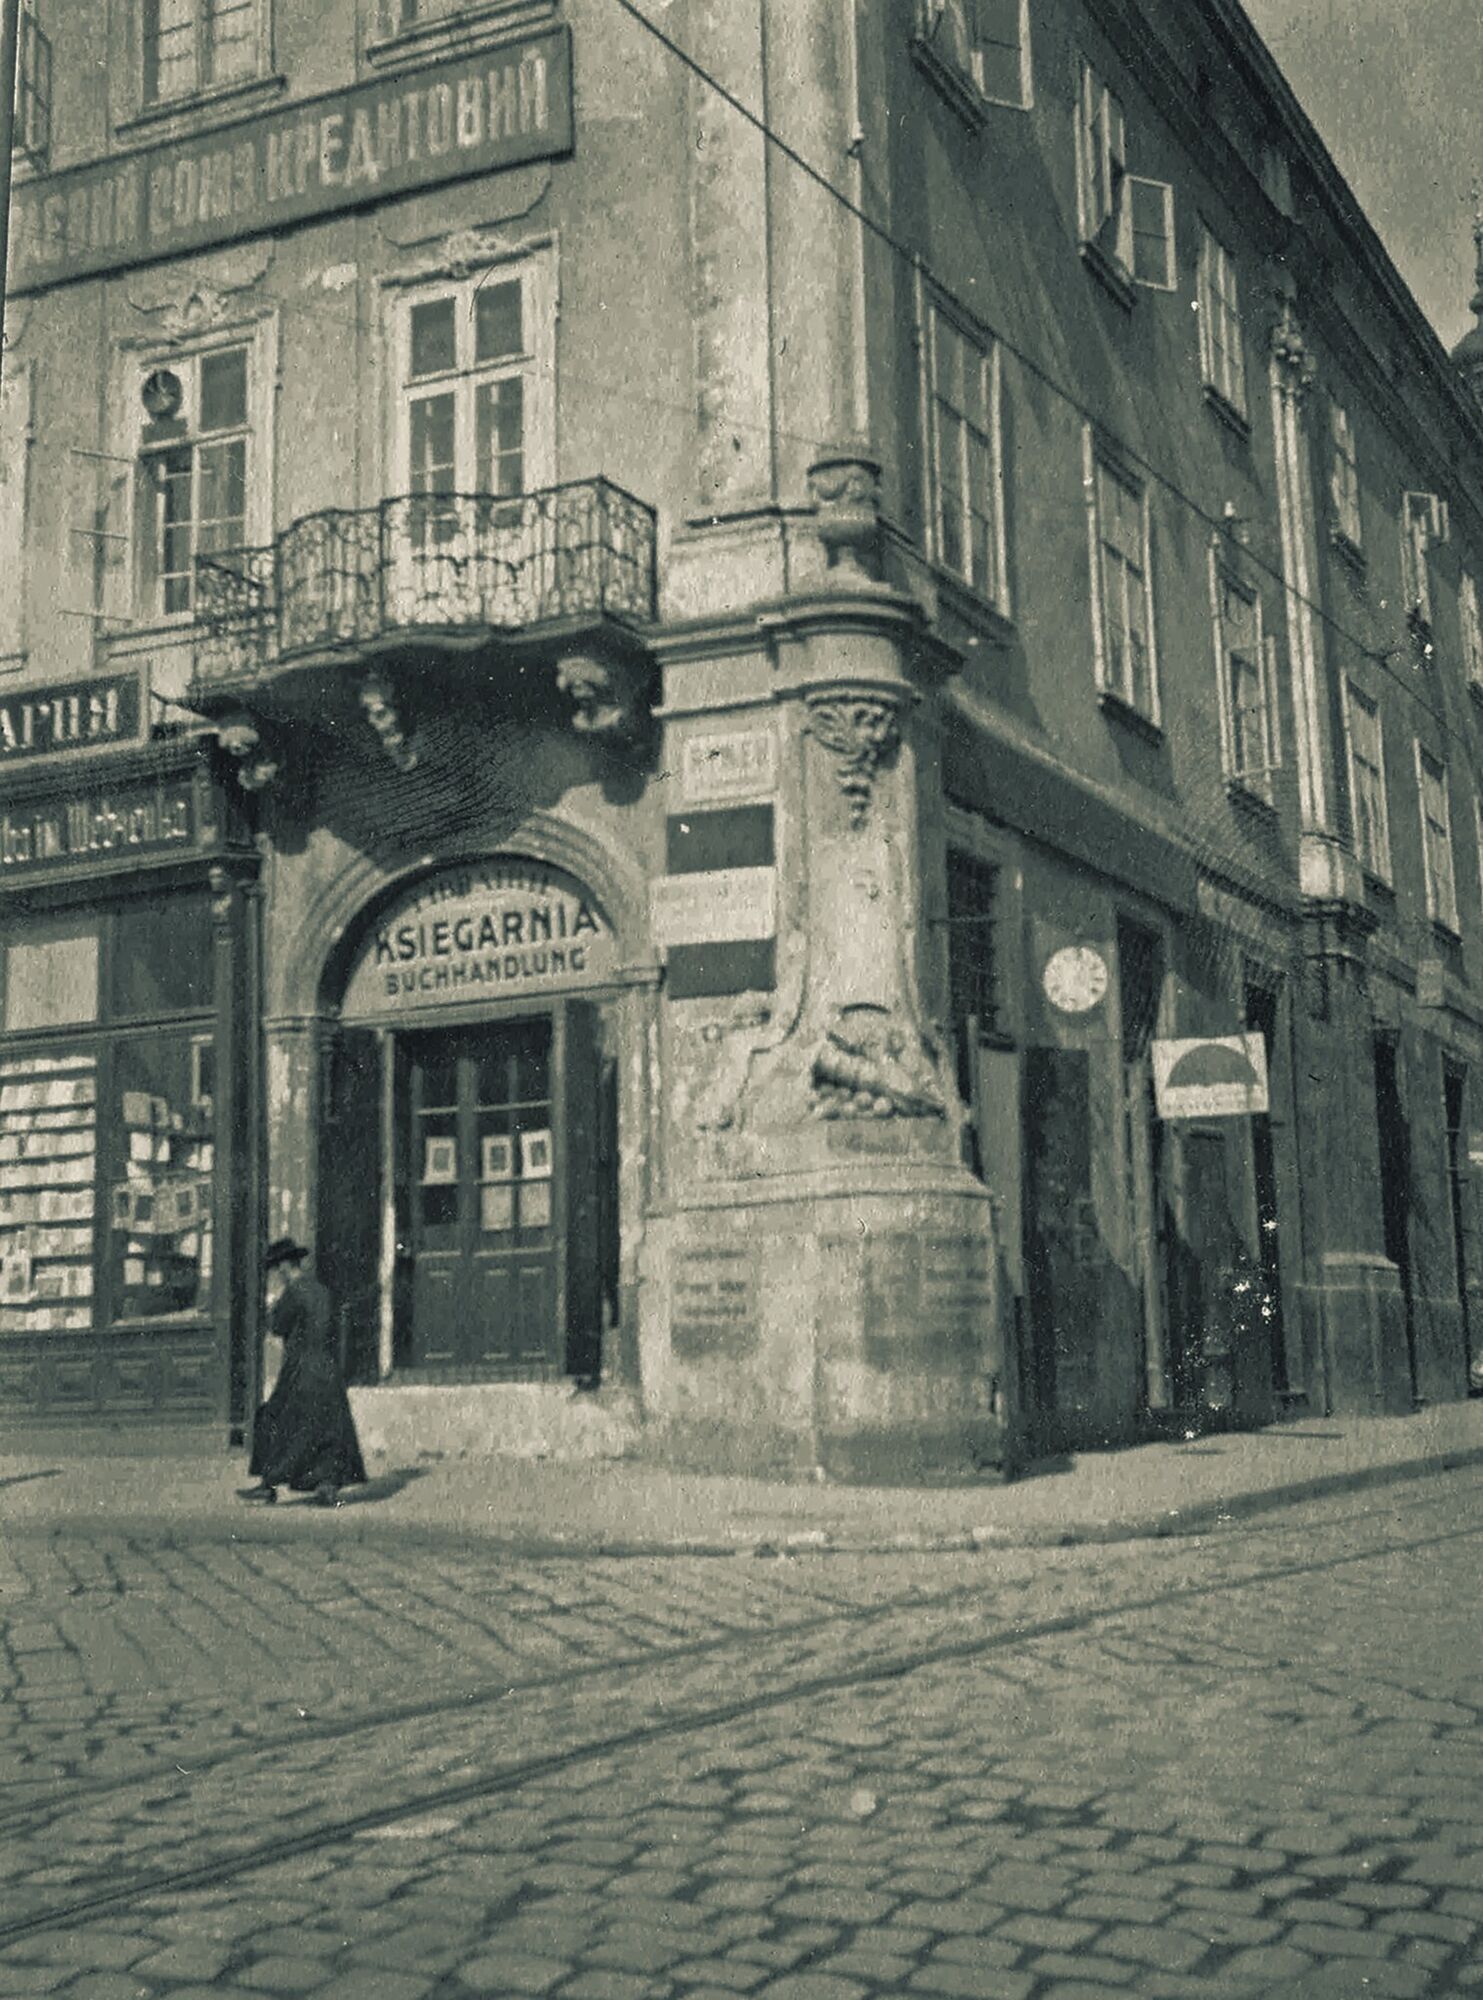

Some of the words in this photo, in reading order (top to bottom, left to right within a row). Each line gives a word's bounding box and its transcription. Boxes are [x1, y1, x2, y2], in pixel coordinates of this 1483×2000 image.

[266, 48, 547, 202] КРЕДИТОВИЙ
[376, 900, 599, 964] KSIEGARNIA
[385, 947, 586, 996] BUCHHANDLUNG
